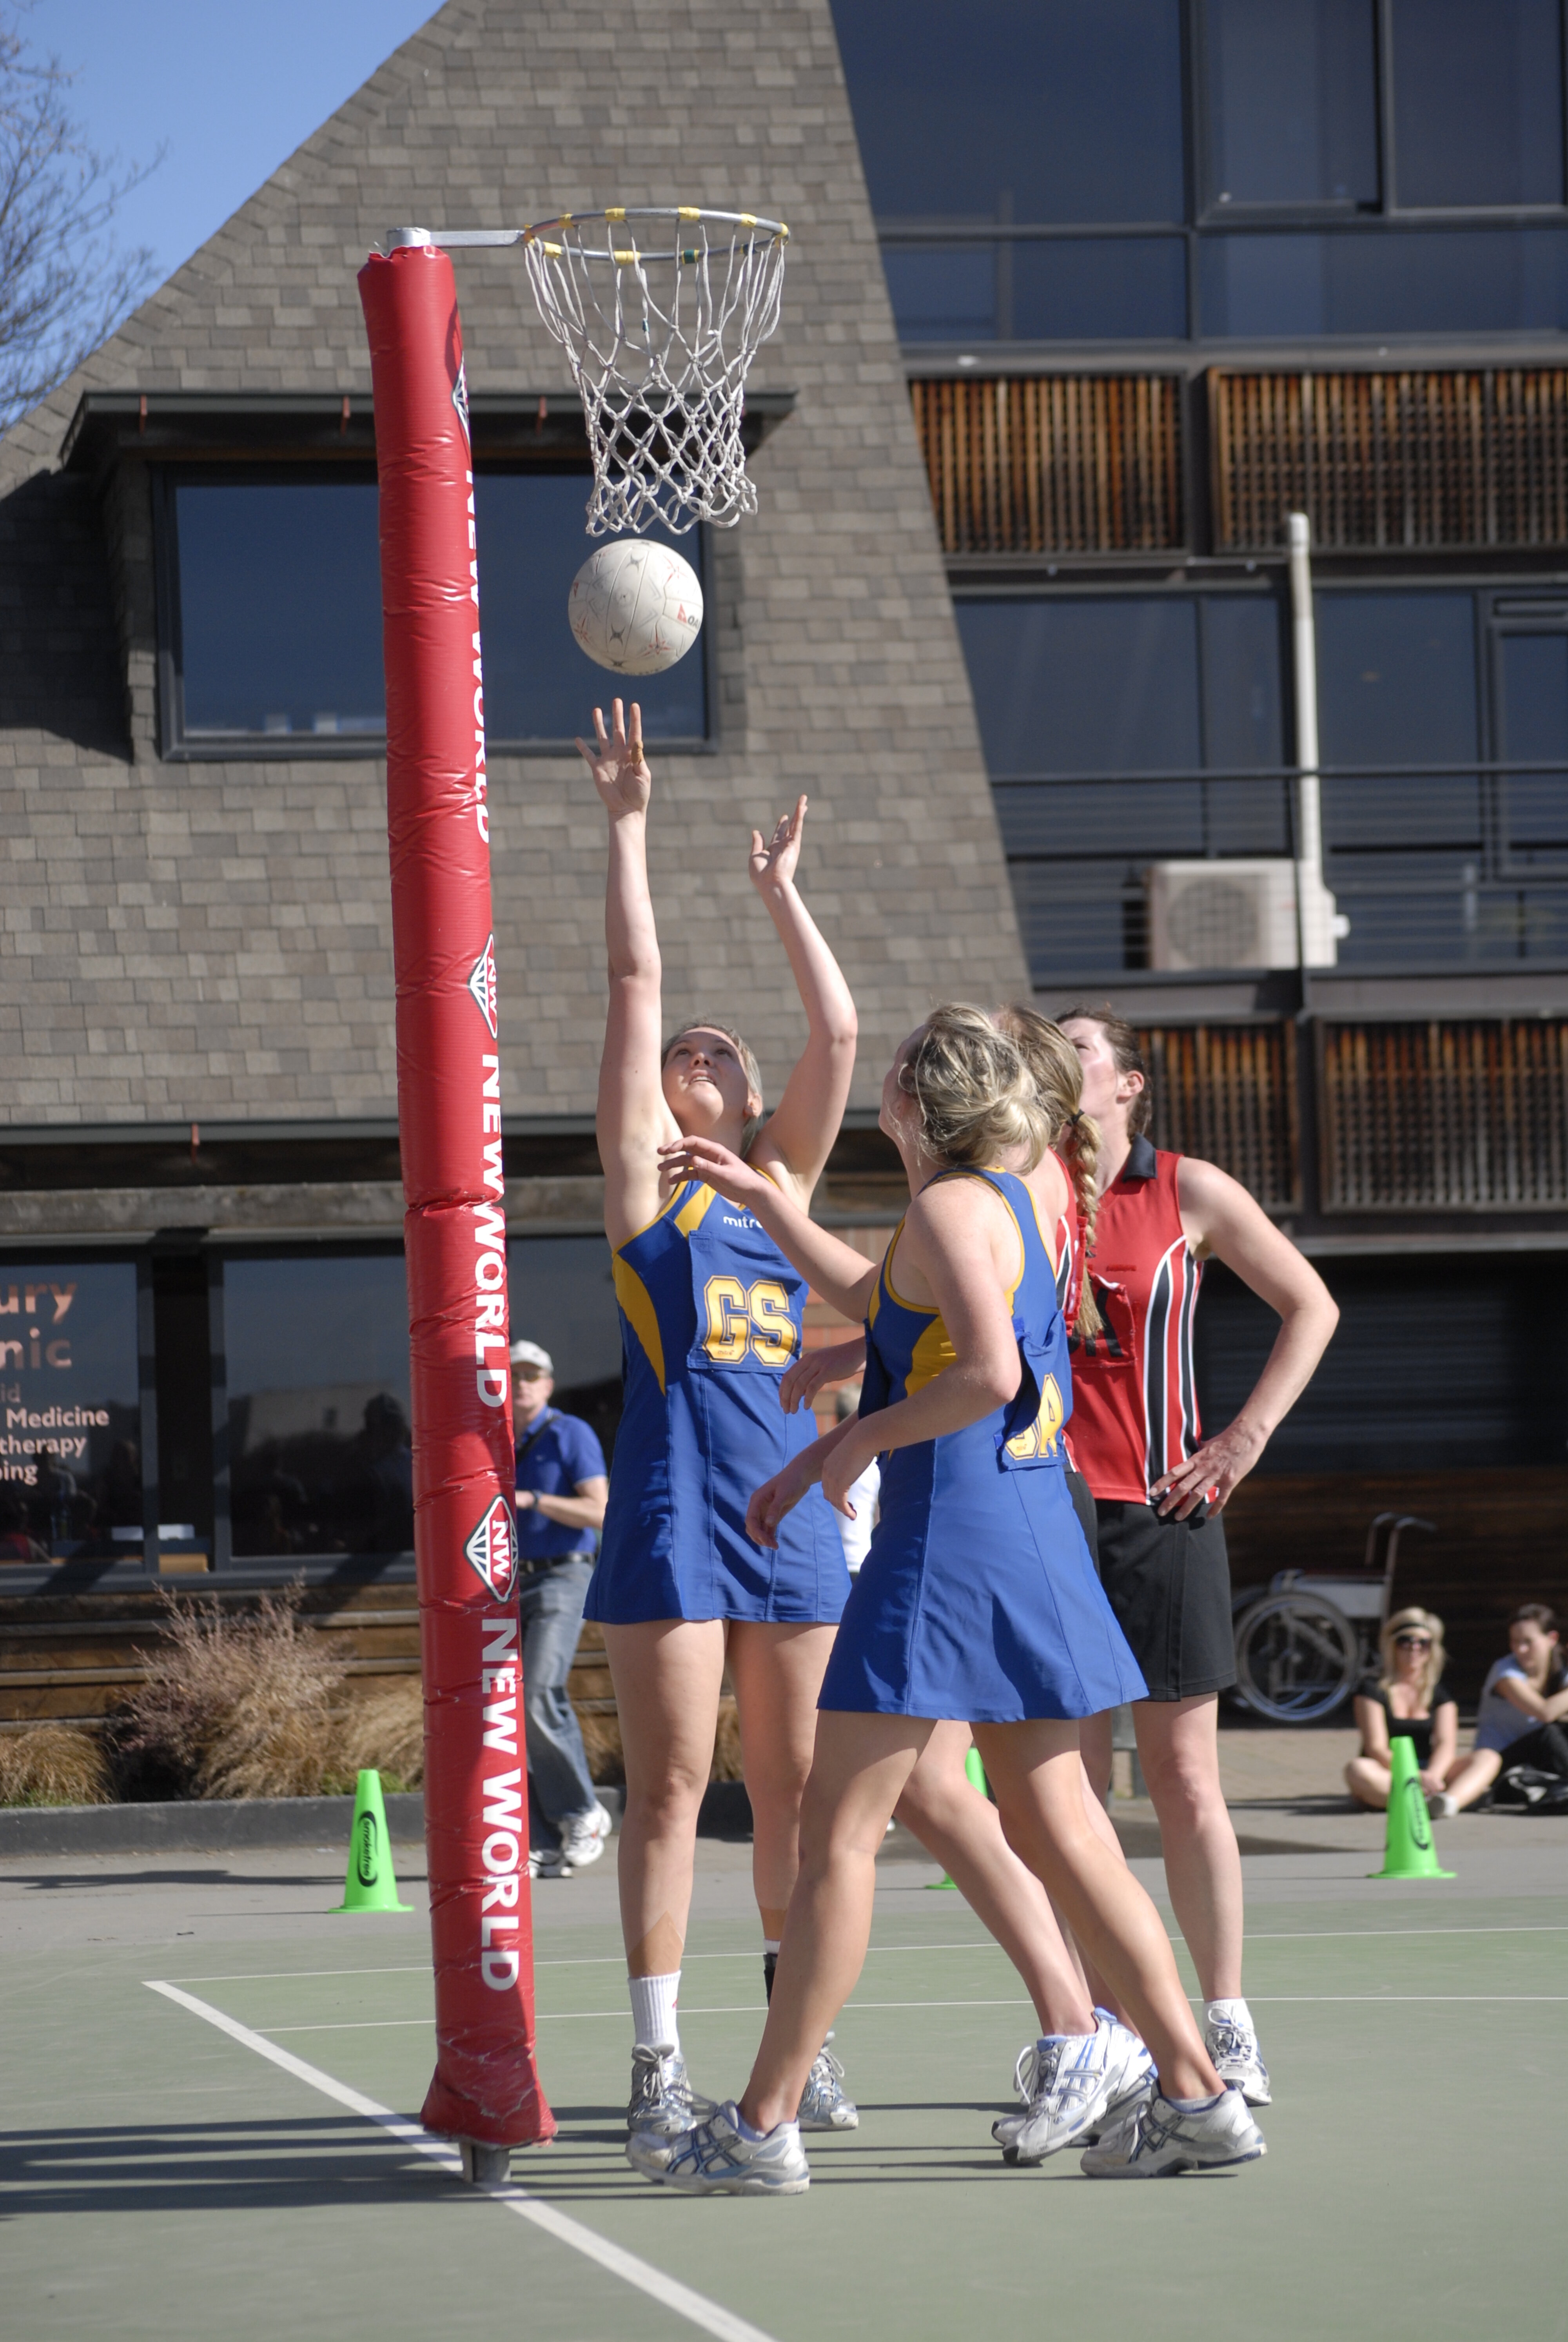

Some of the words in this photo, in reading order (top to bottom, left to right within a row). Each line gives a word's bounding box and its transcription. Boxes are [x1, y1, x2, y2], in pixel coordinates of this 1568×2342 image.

[483, 1054, 505, 1194] NEW
[474, 1203, 507, 1408] WORLD
[702, 1275, 797, 1367] GS
[0, 1327, 72, 1370] nic
[0, 1434, 87, 1459] therapy
[6, 1405, 109, 1428] Medicine
[0, 1460, 38, 1486] ing
[492, 1520, 510, 1580] NW
[482, 1618, 518, 1755] NEW
[481, 1768, 522, 1991] WORLD
